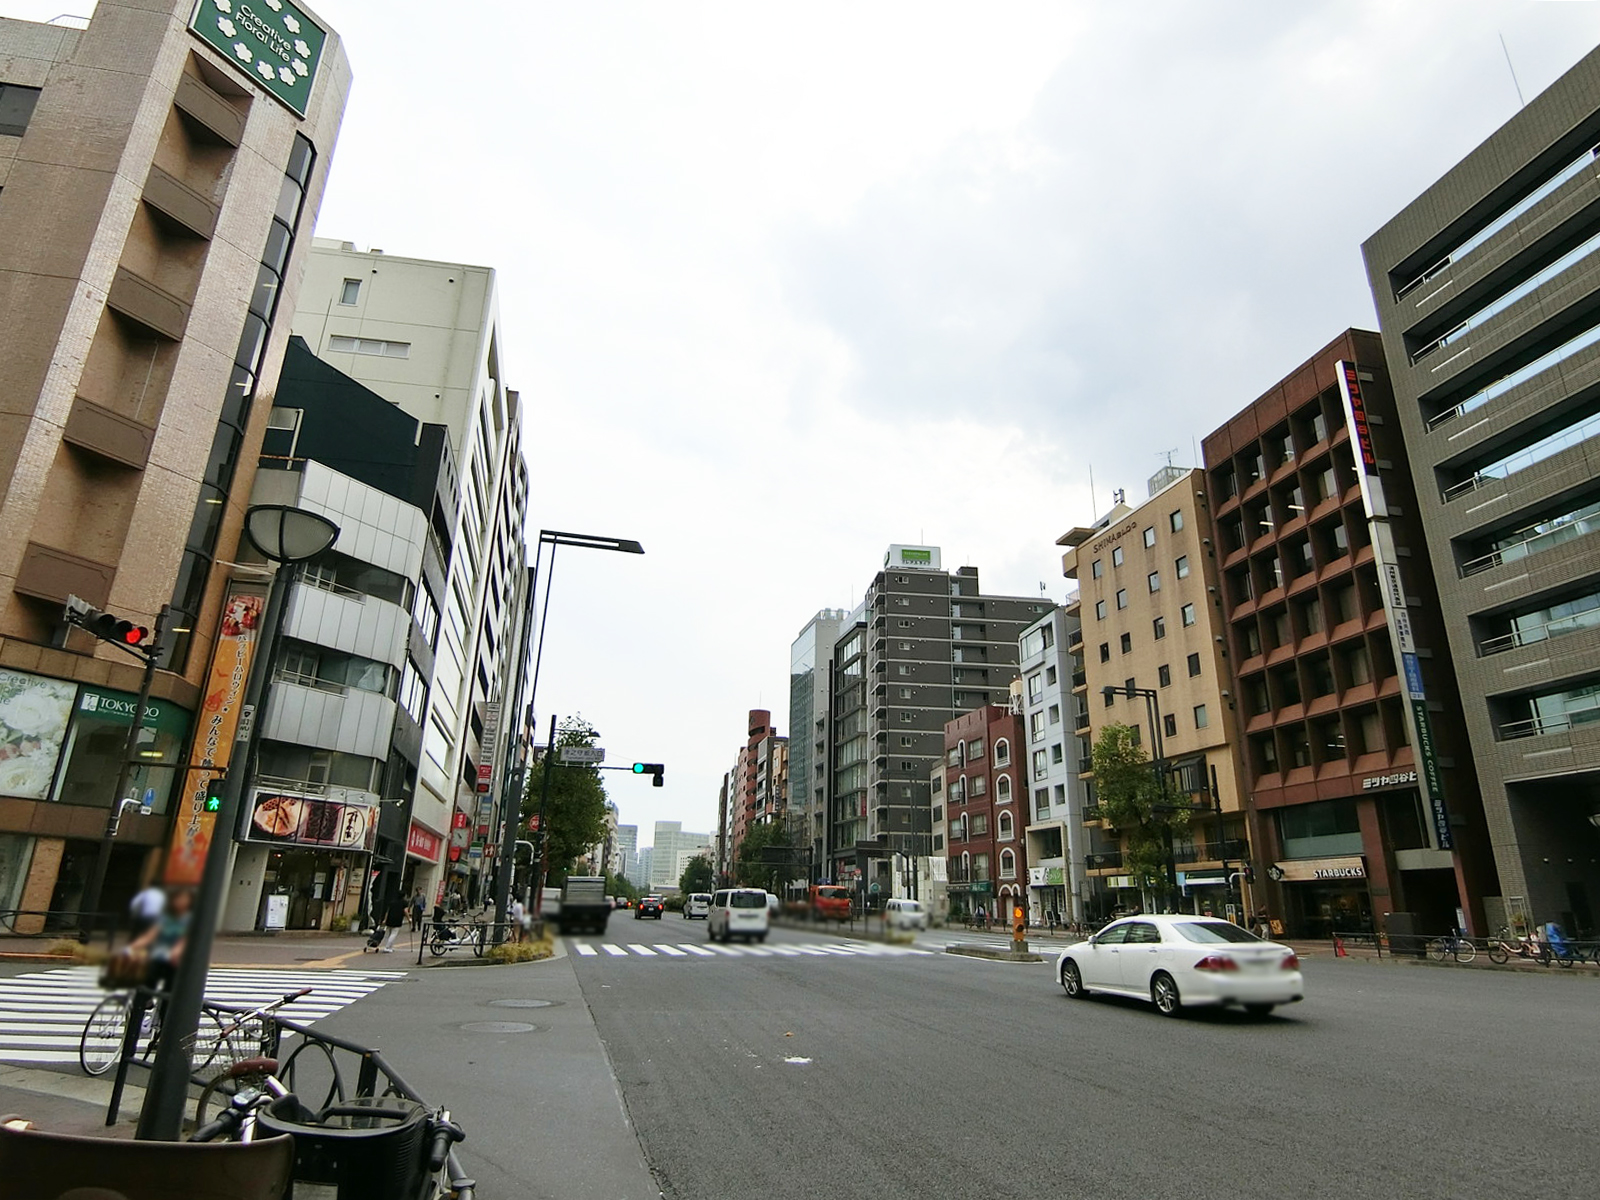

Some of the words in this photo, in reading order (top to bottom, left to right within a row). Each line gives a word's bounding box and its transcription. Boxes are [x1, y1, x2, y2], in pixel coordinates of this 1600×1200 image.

[235, 11, 268, 44] Floral
[269, 41, 290, 62] Life
[240, 4, 291, 51] Creative
[0, 672, 48, 689] Creative
[1415, 705, 1432, 757] STARBUCKS
[1427, 760, 1438, 792] COFFEE
[1312, 867, 1362, 878] STARBUCKS
